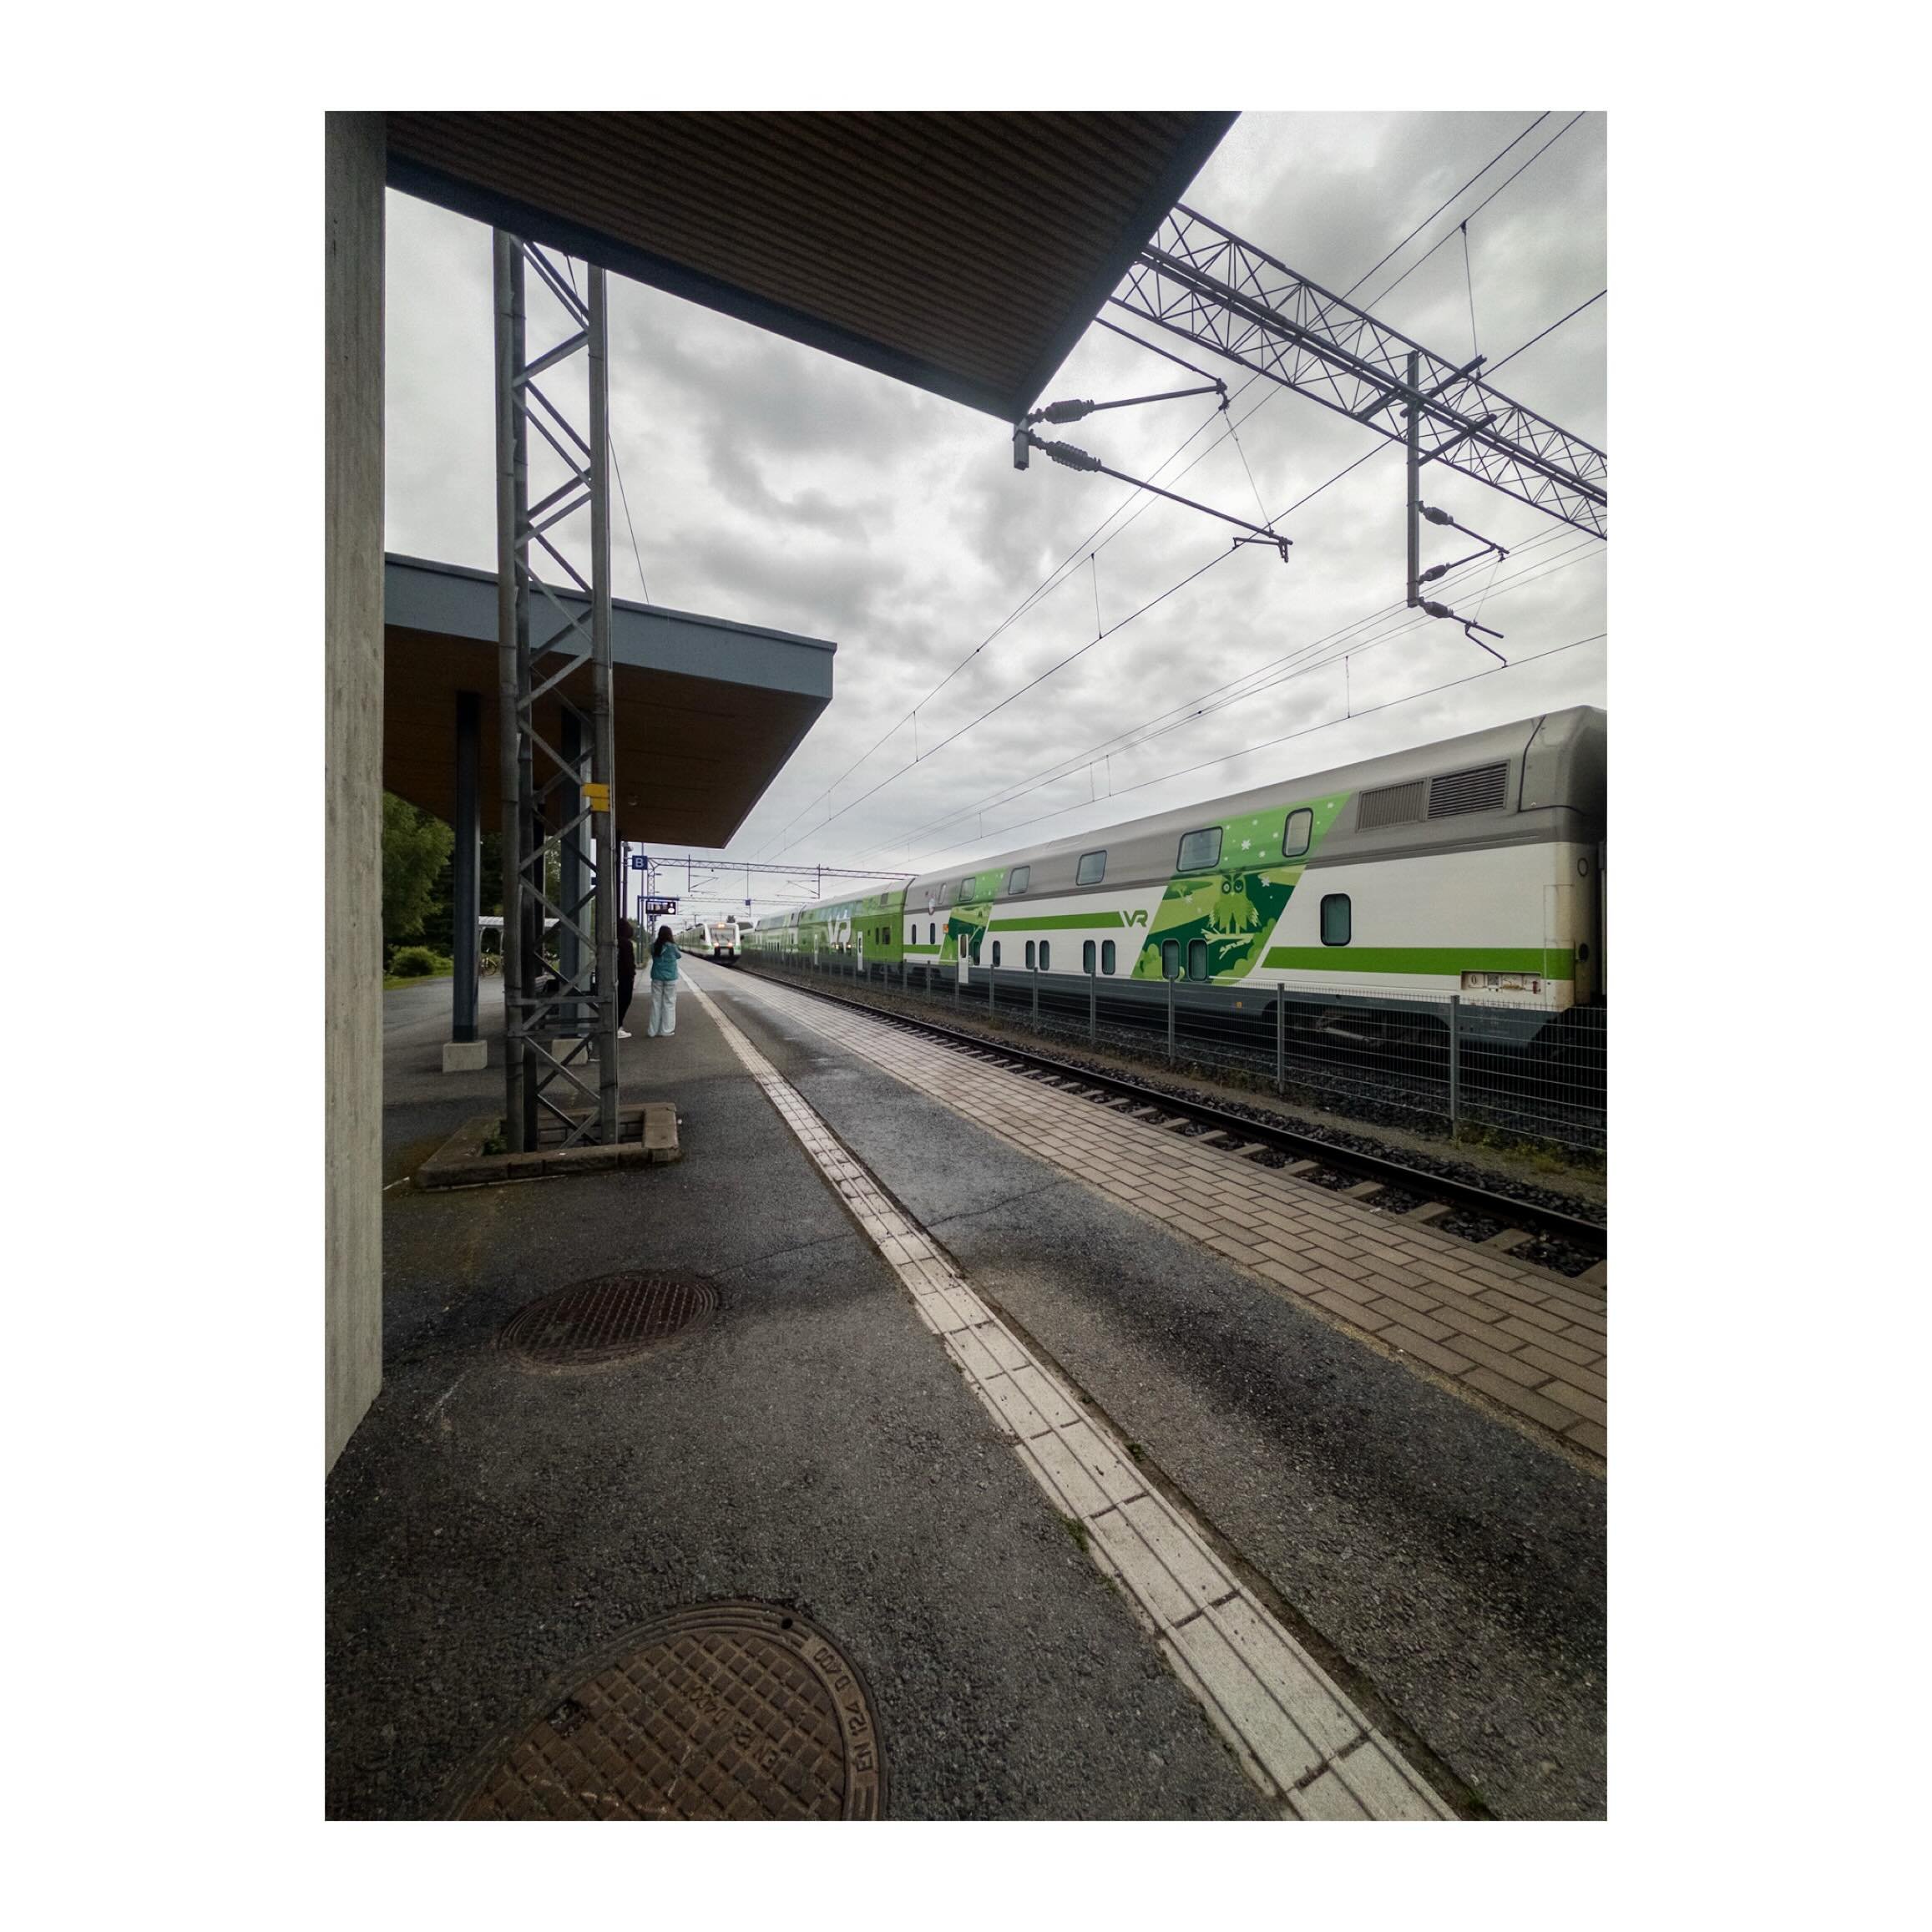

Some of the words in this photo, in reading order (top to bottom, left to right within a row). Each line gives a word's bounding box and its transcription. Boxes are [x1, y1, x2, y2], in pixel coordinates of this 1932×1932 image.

[635, 857, 644, 867] B
[1123, 910, 1148, 928] VR
[835, 1676, 851, 1692] D
[845, 1702, 867, 1737] 124
[854, 1742, 872, 1773] EN
